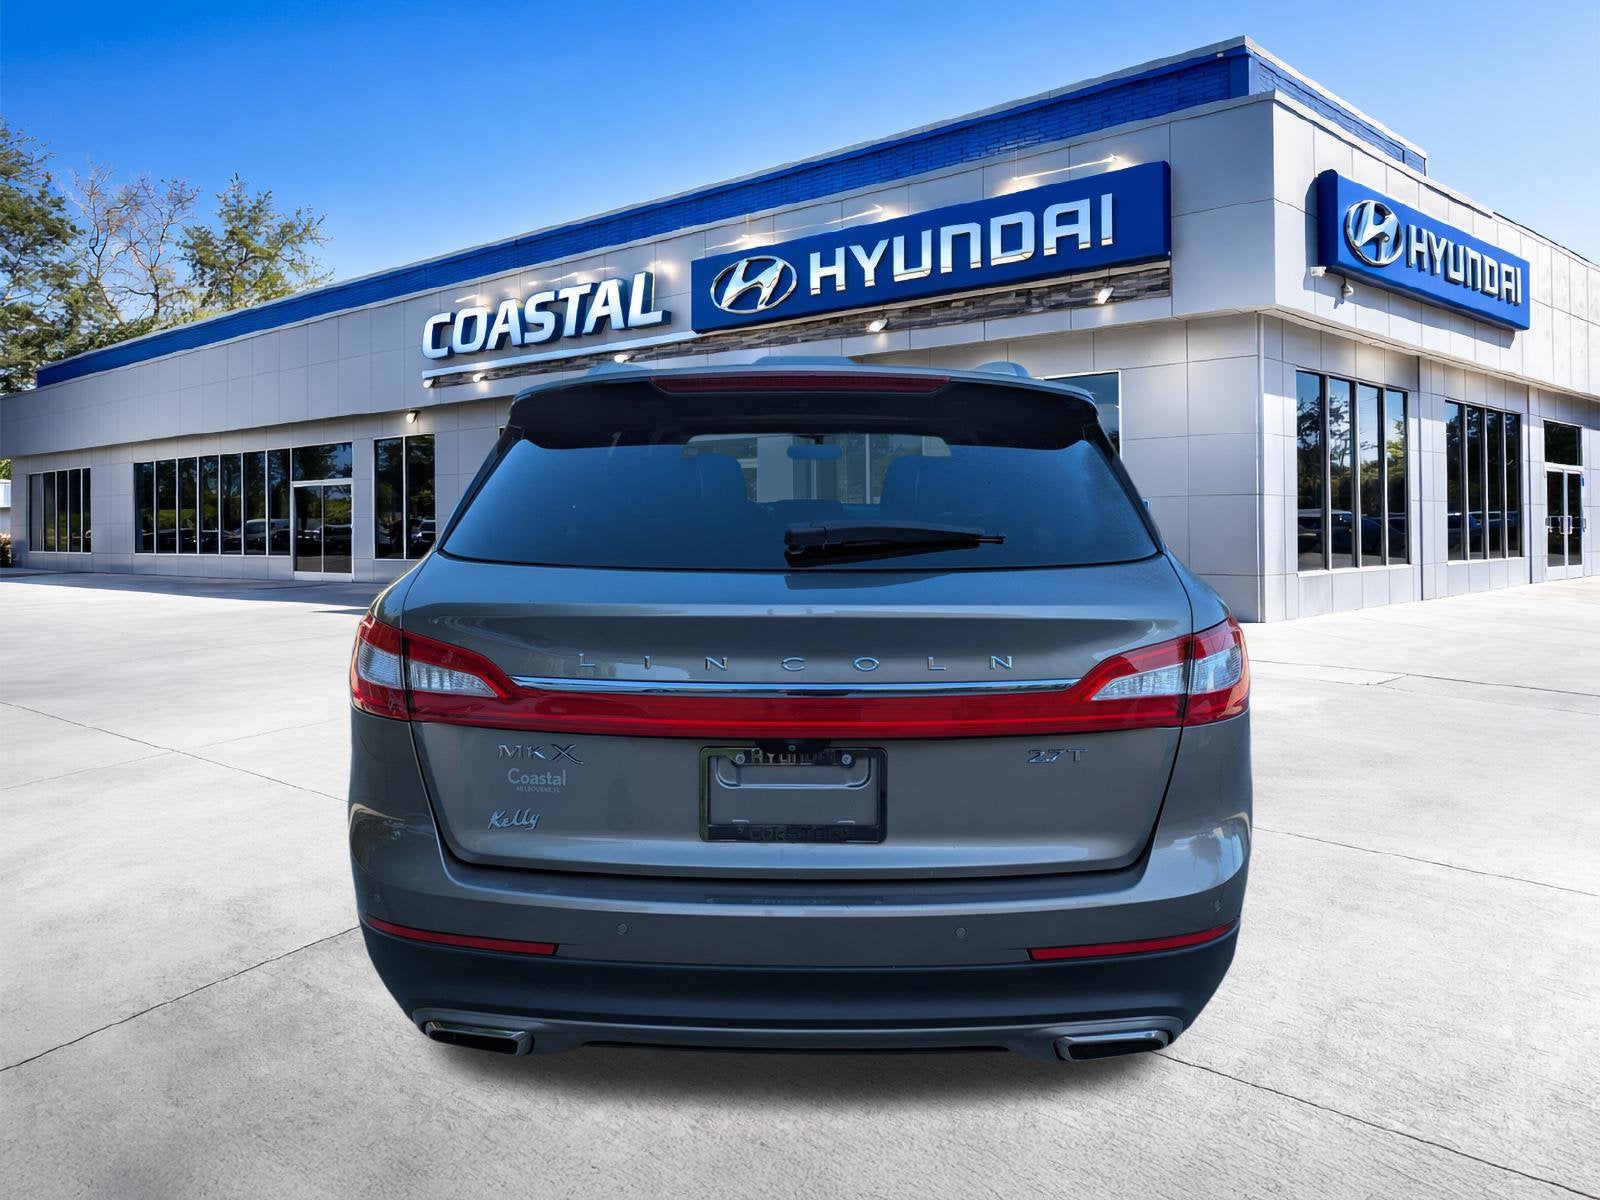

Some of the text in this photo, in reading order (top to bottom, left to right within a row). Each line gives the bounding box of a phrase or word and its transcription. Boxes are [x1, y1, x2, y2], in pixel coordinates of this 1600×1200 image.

[808, 193, 1115, 297] HYUNDAI
[1406, 224, 1523, 307] HYUNDAI
[421, 270, 667, 361] COASTAL
[578, 652, 1014, 672] LINCOLN
[498, 744, 584, 764] MKX
[507, 767, 566, 786] Coastal
[488, 809, 540, 831] Kelly
